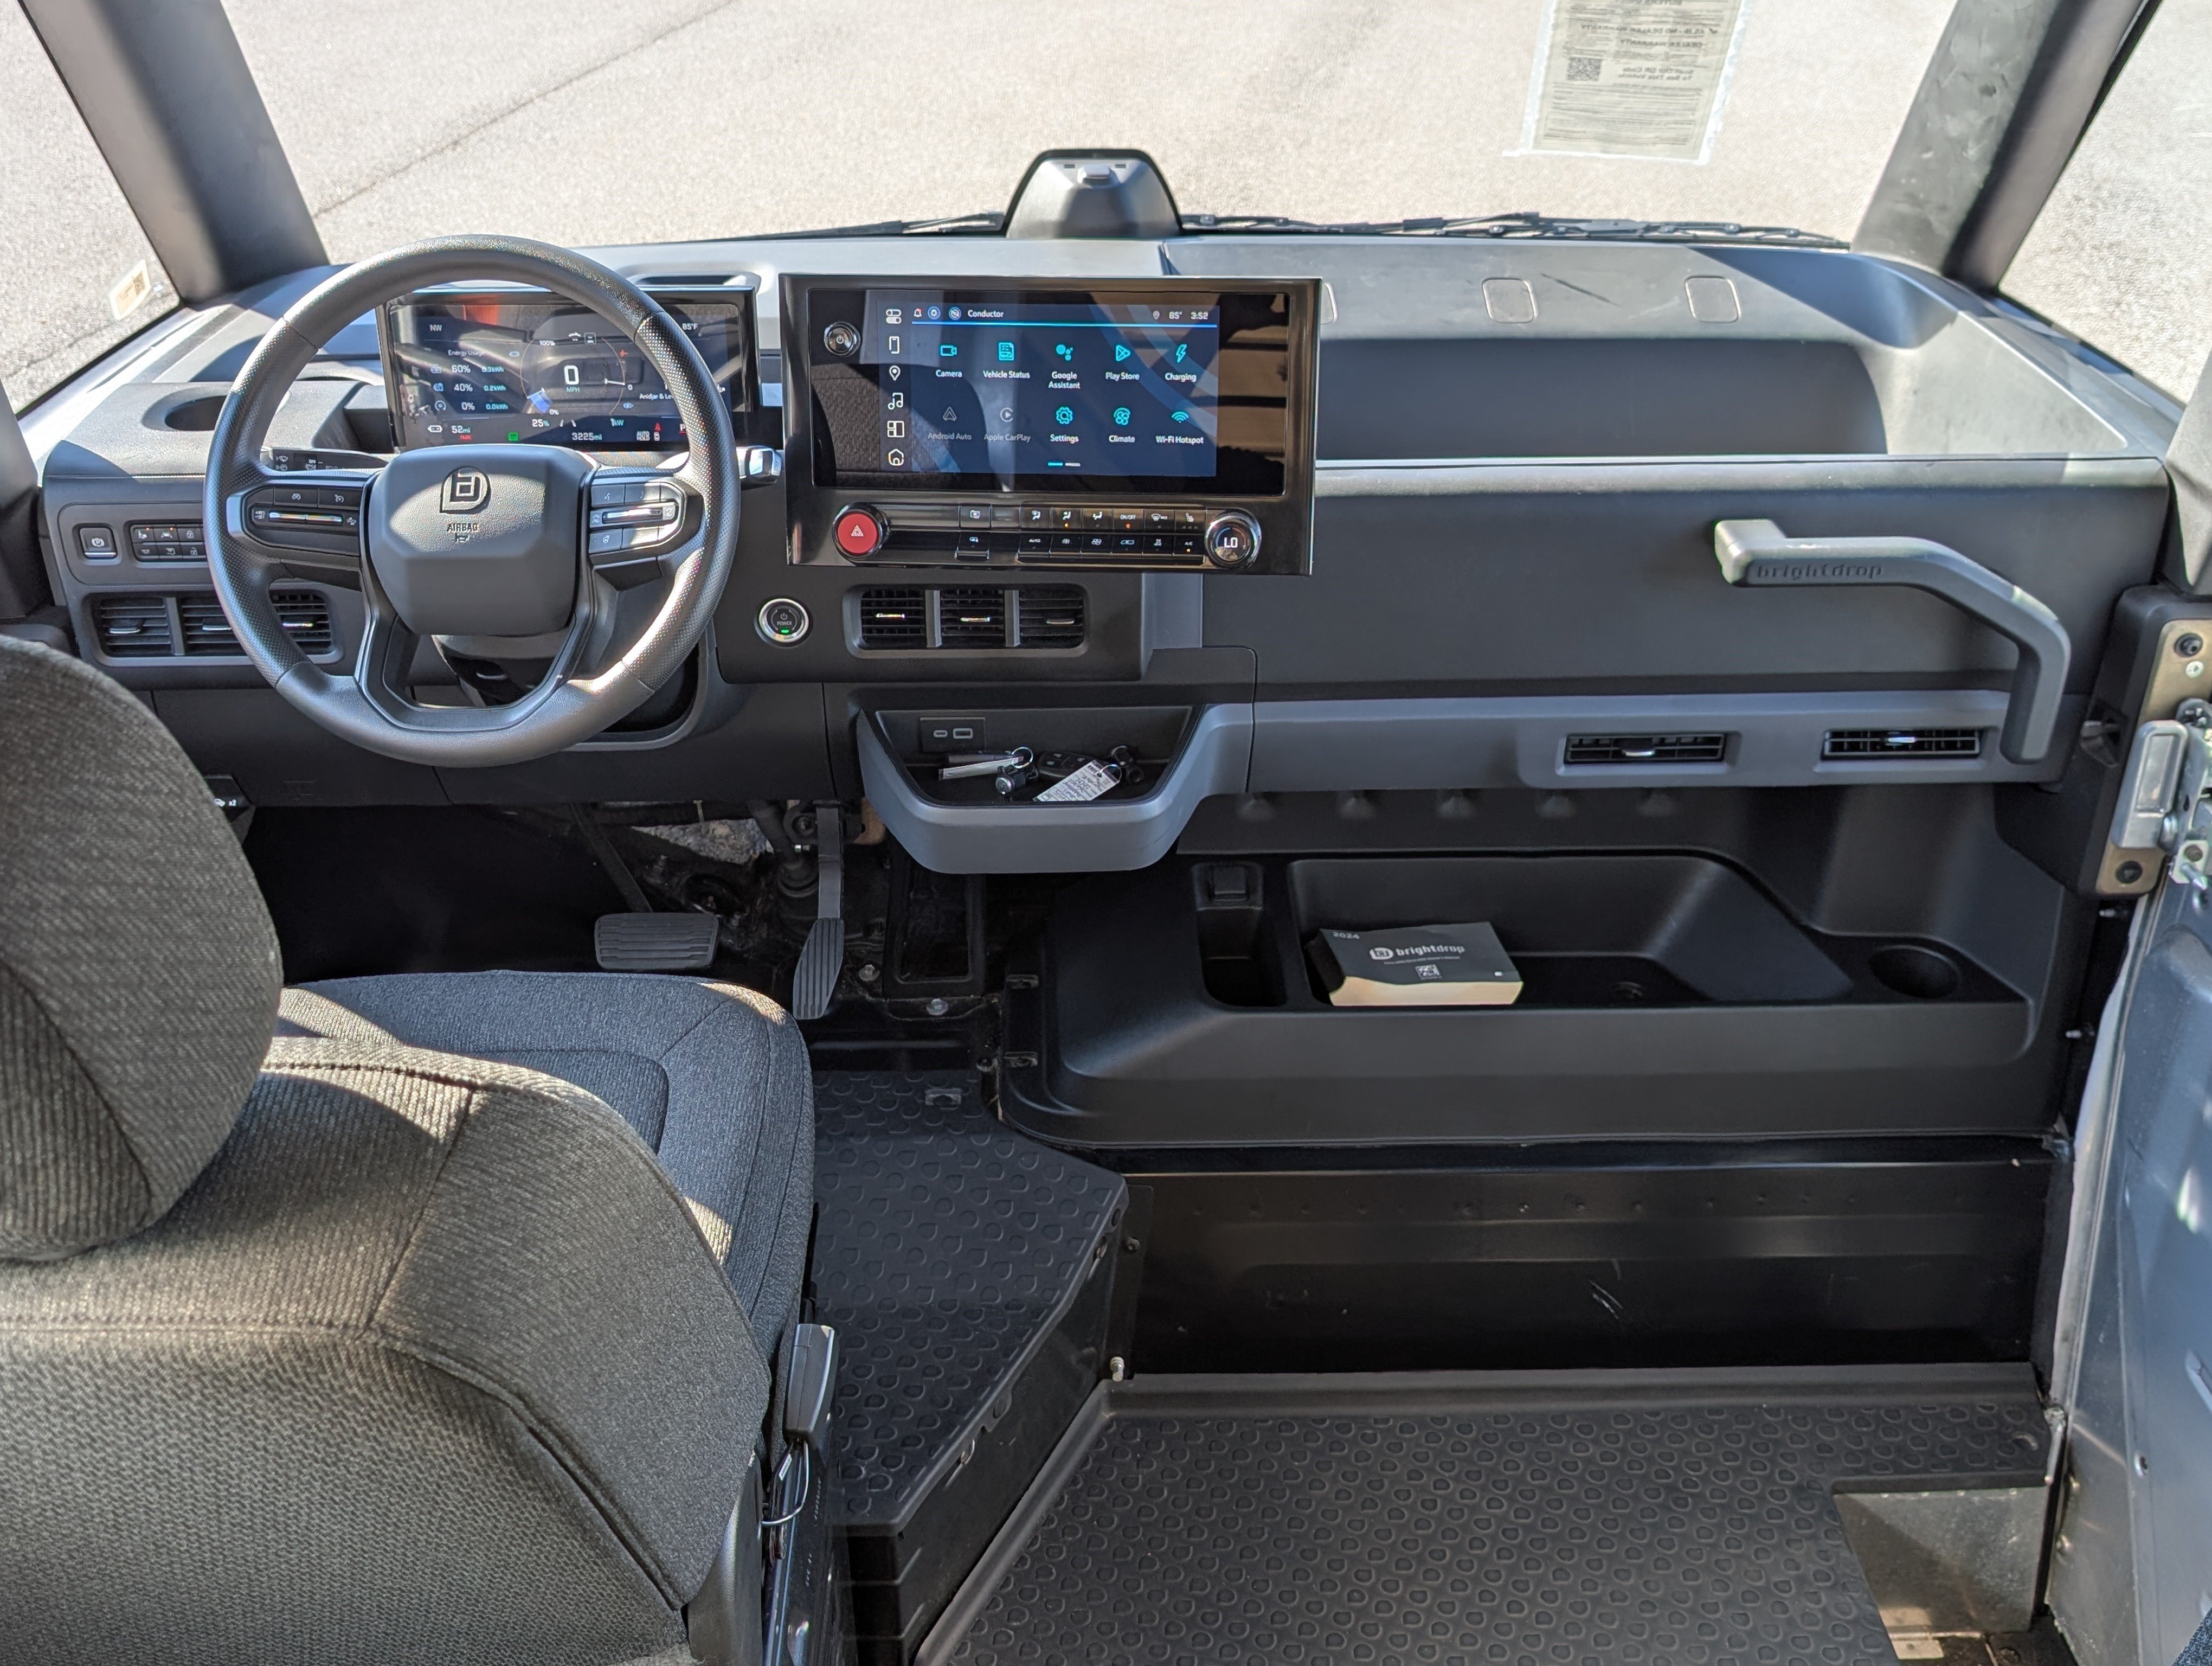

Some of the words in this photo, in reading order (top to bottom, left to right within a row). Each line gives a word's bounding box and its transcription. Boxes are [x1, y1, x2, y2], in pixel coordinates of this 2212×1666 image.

[967, 309, 1004, 318] Conductor
[1191, 311, 1208, 320] 3:52
[452, 364, 471, 373] 60%
[563, 365, 579, 386] 0
[936, 370, 963, 379] Camera
[982, 370, 1007, 379] Vehicle
[1008, 370, 1031, 379] Status
[1052, 371, 1077, 381] Google
[1105, 371, 1120, 381] Play
[1121, 372, 1140, 380] Store
[1165, 372, 1197, 383] Charging
[454, 383, 473, 392] 40%
[1048, 380, 1081, 390] Assistant
[461, 401, 475, 411] 0%
[532, 419, 550, 428] 25%
[451, 425, 471, 434] 52mi
[572, 432, 602, 440] 3225mi
[928, 432, 954, 440] Android
[984, 434, 1003, 443] Apple
[1005, 434, 1031, 443] CarPlay
[1050, 434, 1079, 445] Settings
[1109, 435, 1135, 444] Climate
[1156, 435, 1175, 444] Wi-Fi
[1175, 435, 1204, 446] Hotspot
[447, 523, 479, 533] AIRBAG
[1224, 537, 1238, 548] LO
[1757, 563, 1883, 581] brightdrop
[1333, 931, 1360, 940] 2024
[1396, 945, 1466, 956] brightdrop
